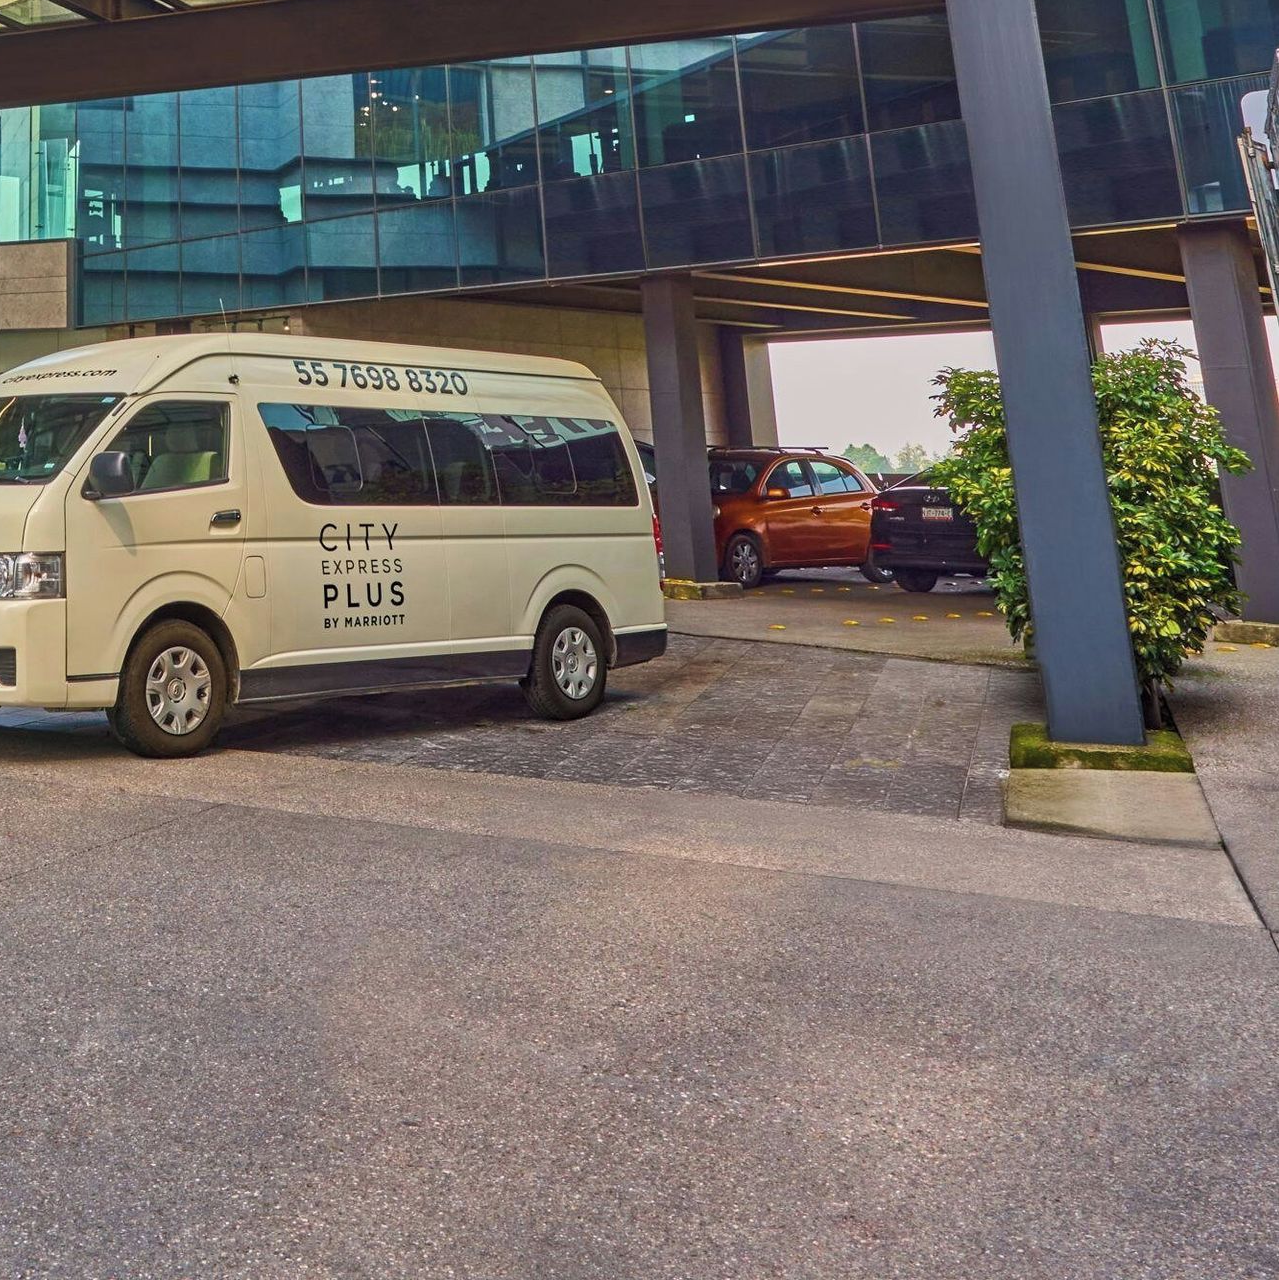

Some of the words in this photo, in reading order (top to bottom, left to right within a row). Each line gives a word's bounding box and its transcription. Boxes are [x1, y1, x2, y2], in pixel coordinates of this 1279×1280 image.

[292, 359, 329, 387] 55
[333, 362, 401, 391] 7698
[405, 368, 468, 396] 8320
[319, 523, 398, 552] CITY
[322, 558, 403, 575] EXPRESS
[323, 581, 405, 609] PLUS
[324, 617, 339, 629] BY
[344, 614, 406, 628] MARRIOTT
